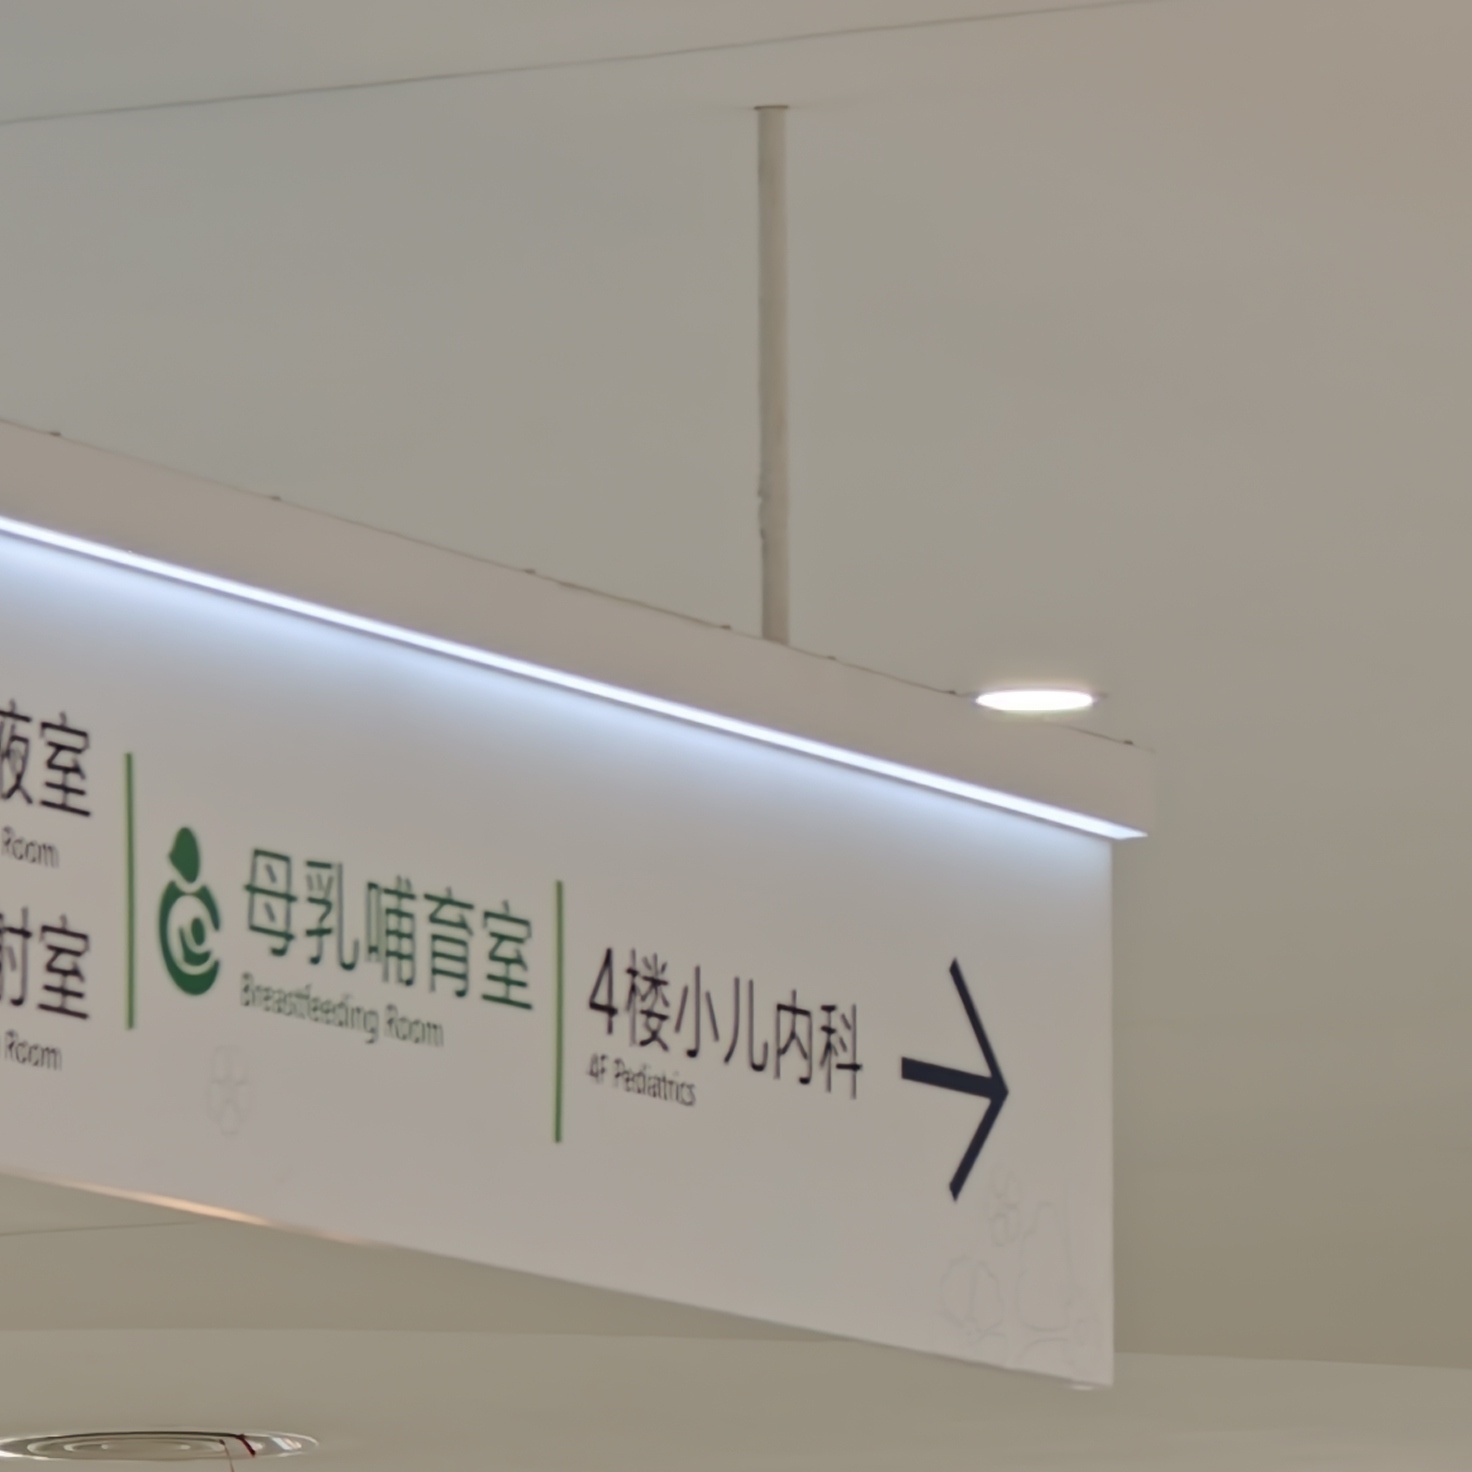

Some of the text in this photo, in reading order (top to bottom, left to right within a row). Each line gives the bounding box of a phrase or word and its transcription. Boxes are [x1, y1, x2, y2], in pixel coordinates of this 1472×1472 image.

[1, 827, 60, 870] Room
[243, 847, 535, 1013] 母乳哺育室
[240, 972, 445, 1050] Breastfeeding Room
[586, 946, 864, 1100] 4楼小儿内科
[3, 1024, 63, 1072] Room
[586, 1053, 699, 1108] 4F Pediatrics
